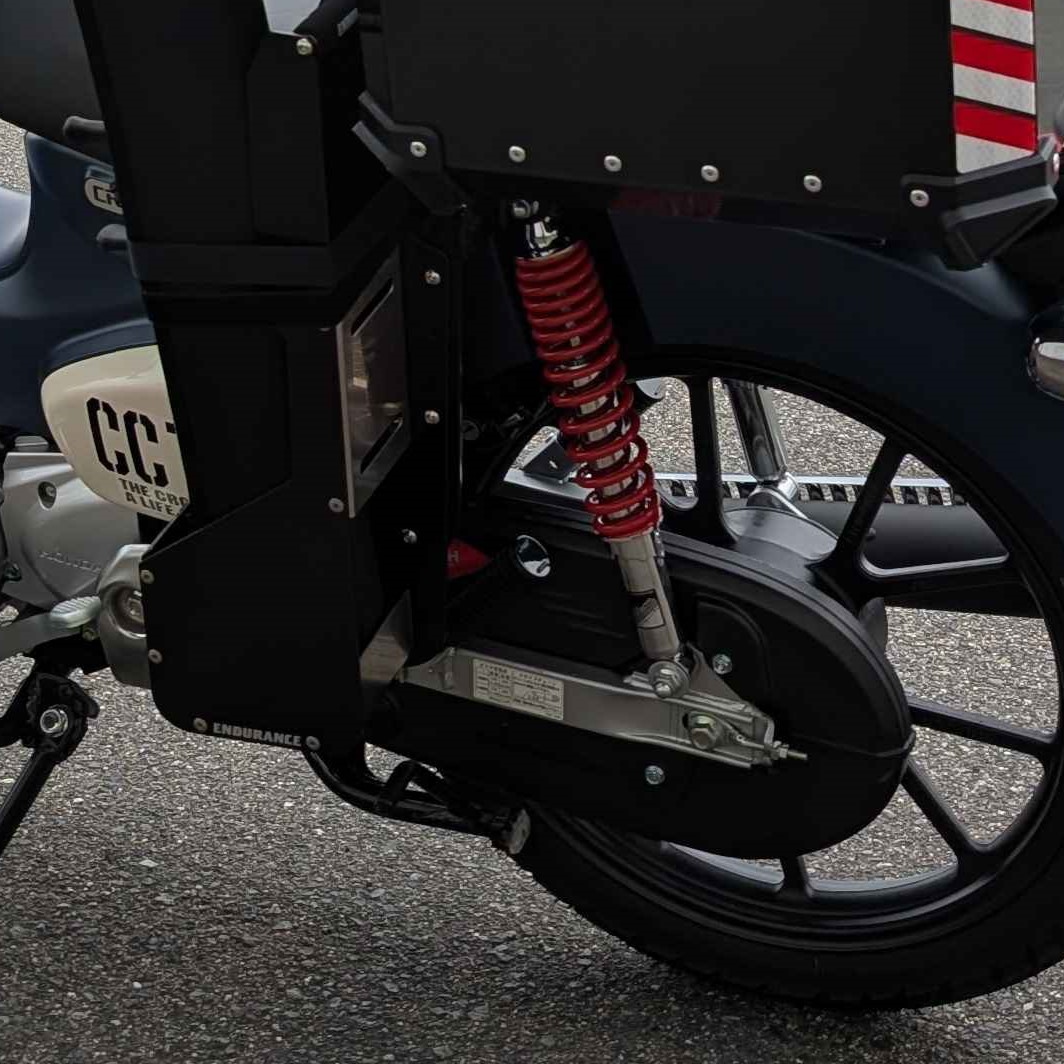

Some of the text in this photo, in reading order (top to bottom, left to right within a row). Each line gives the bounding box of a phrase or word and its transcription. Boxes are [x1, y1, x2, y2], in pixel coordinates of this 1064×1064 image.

[86, 397, 176, 487] CC
[118, 478, 150, 497] THE
[125, 491, 138, 505] A
[212, 721, 302, 747] ENDURANCE
